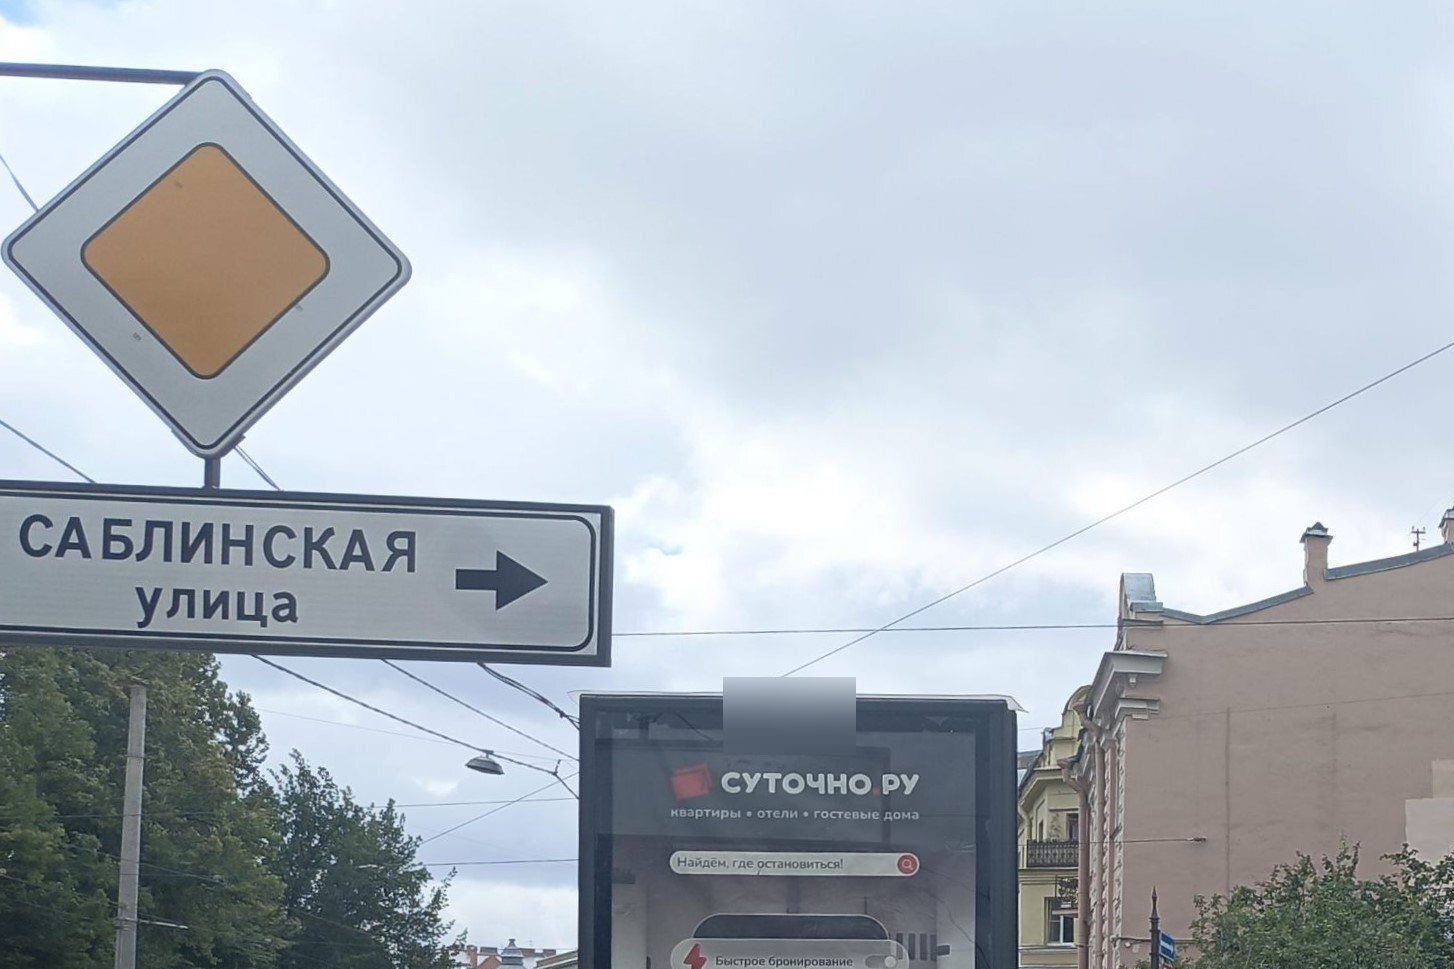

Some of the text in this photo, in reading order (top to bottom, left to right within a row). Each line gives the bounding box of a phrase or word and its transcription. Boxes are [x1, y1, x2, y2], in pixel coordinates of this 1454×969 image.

[19, 513, 417, 573] САБЛИНСКАЯ
[135, 586, 298, 628] улица
[721, 772, 920, 795] СУТОЧНО.РУ
[671, 809, 920, 822] квартиры отели гостевые дома
[677, 857, 844, 871] Найдём, где остановиться!
[715, 956, 853, 967] Быстрое бронирование
